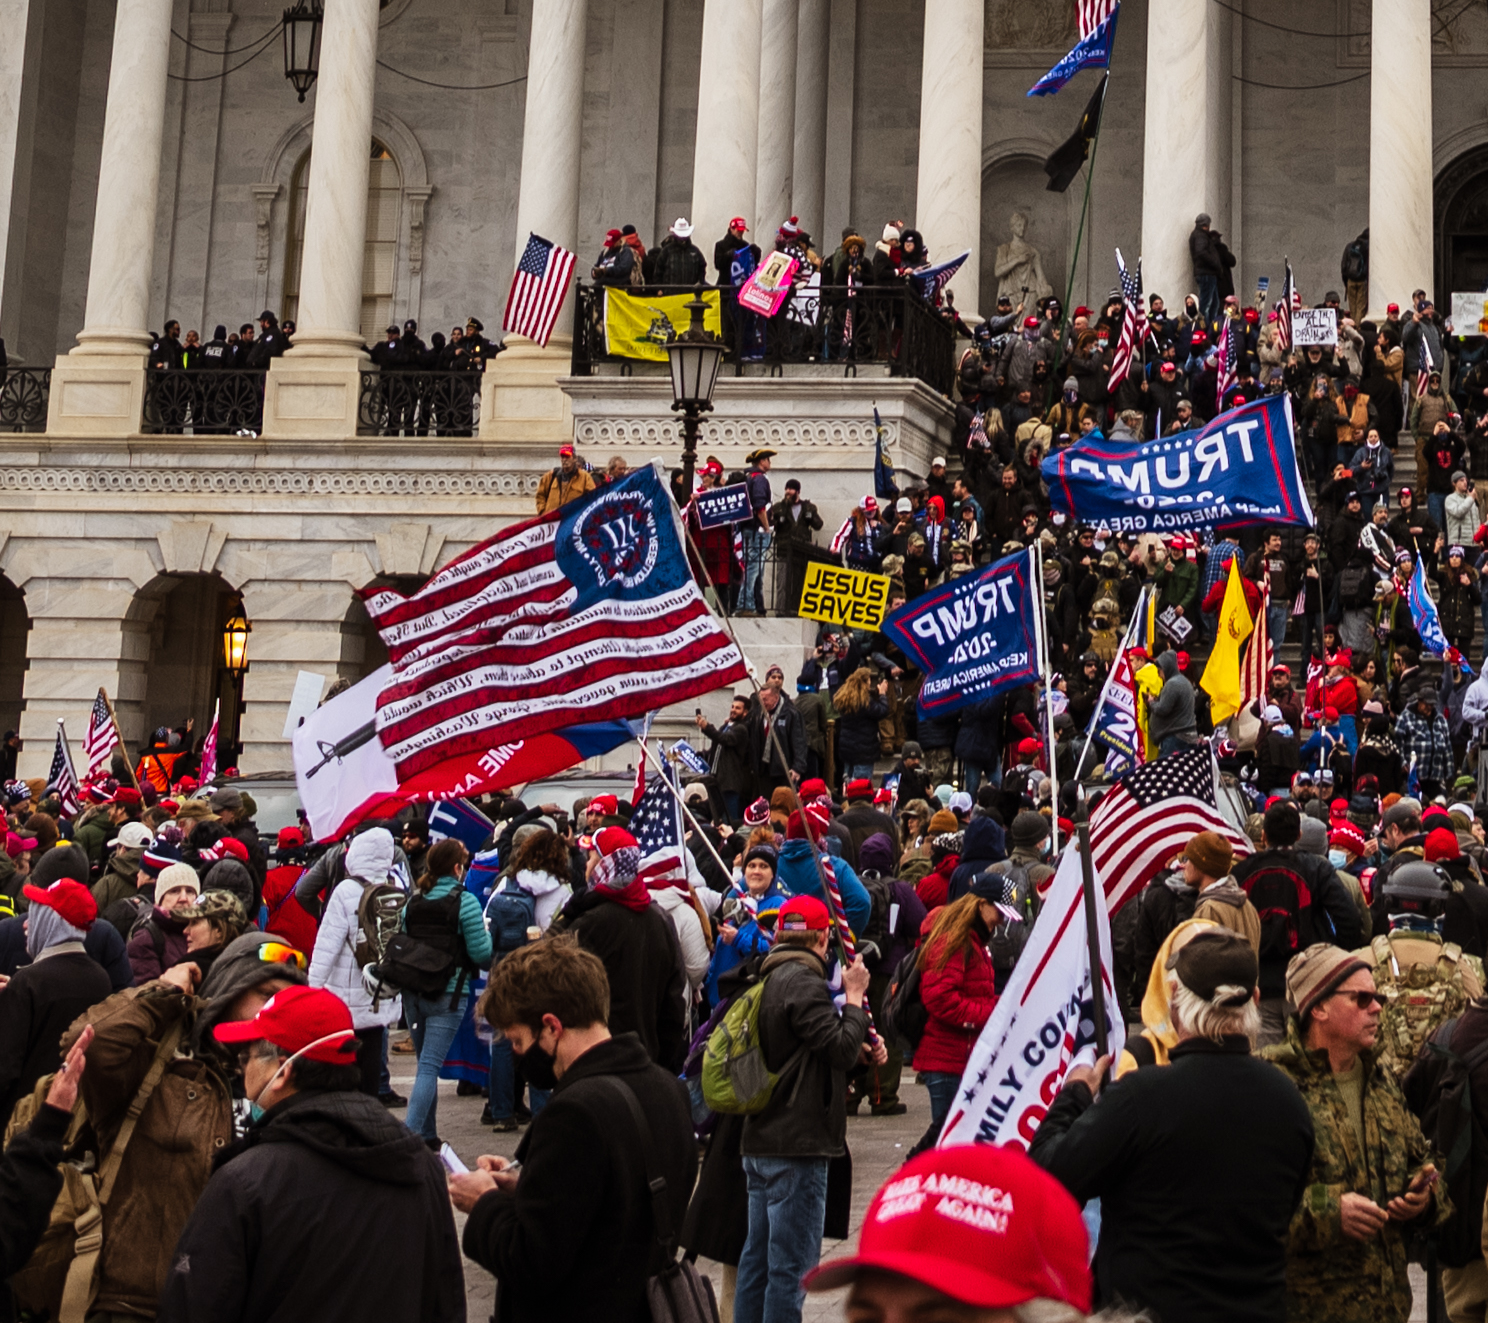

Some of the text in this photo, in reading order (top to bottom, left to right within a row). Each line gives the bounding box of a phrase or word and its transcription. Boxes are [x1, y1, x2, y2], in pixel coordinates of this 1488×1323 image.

[747, 285, 773, 303] Latinos
[698, 492, 747, 510] TRUMP
[704, 501, 744, 516] PENCE
[807, 568, 886, 602] JESUS
[801, 591, 883, 626] SAVES
[1099, 729, 1134, 755] President
[974, 1063, 1023, 1146] MILY
[921, 1172, 1015, 1214] AMERICA
[934, 1195, 1010, 1234] AGAIN!
